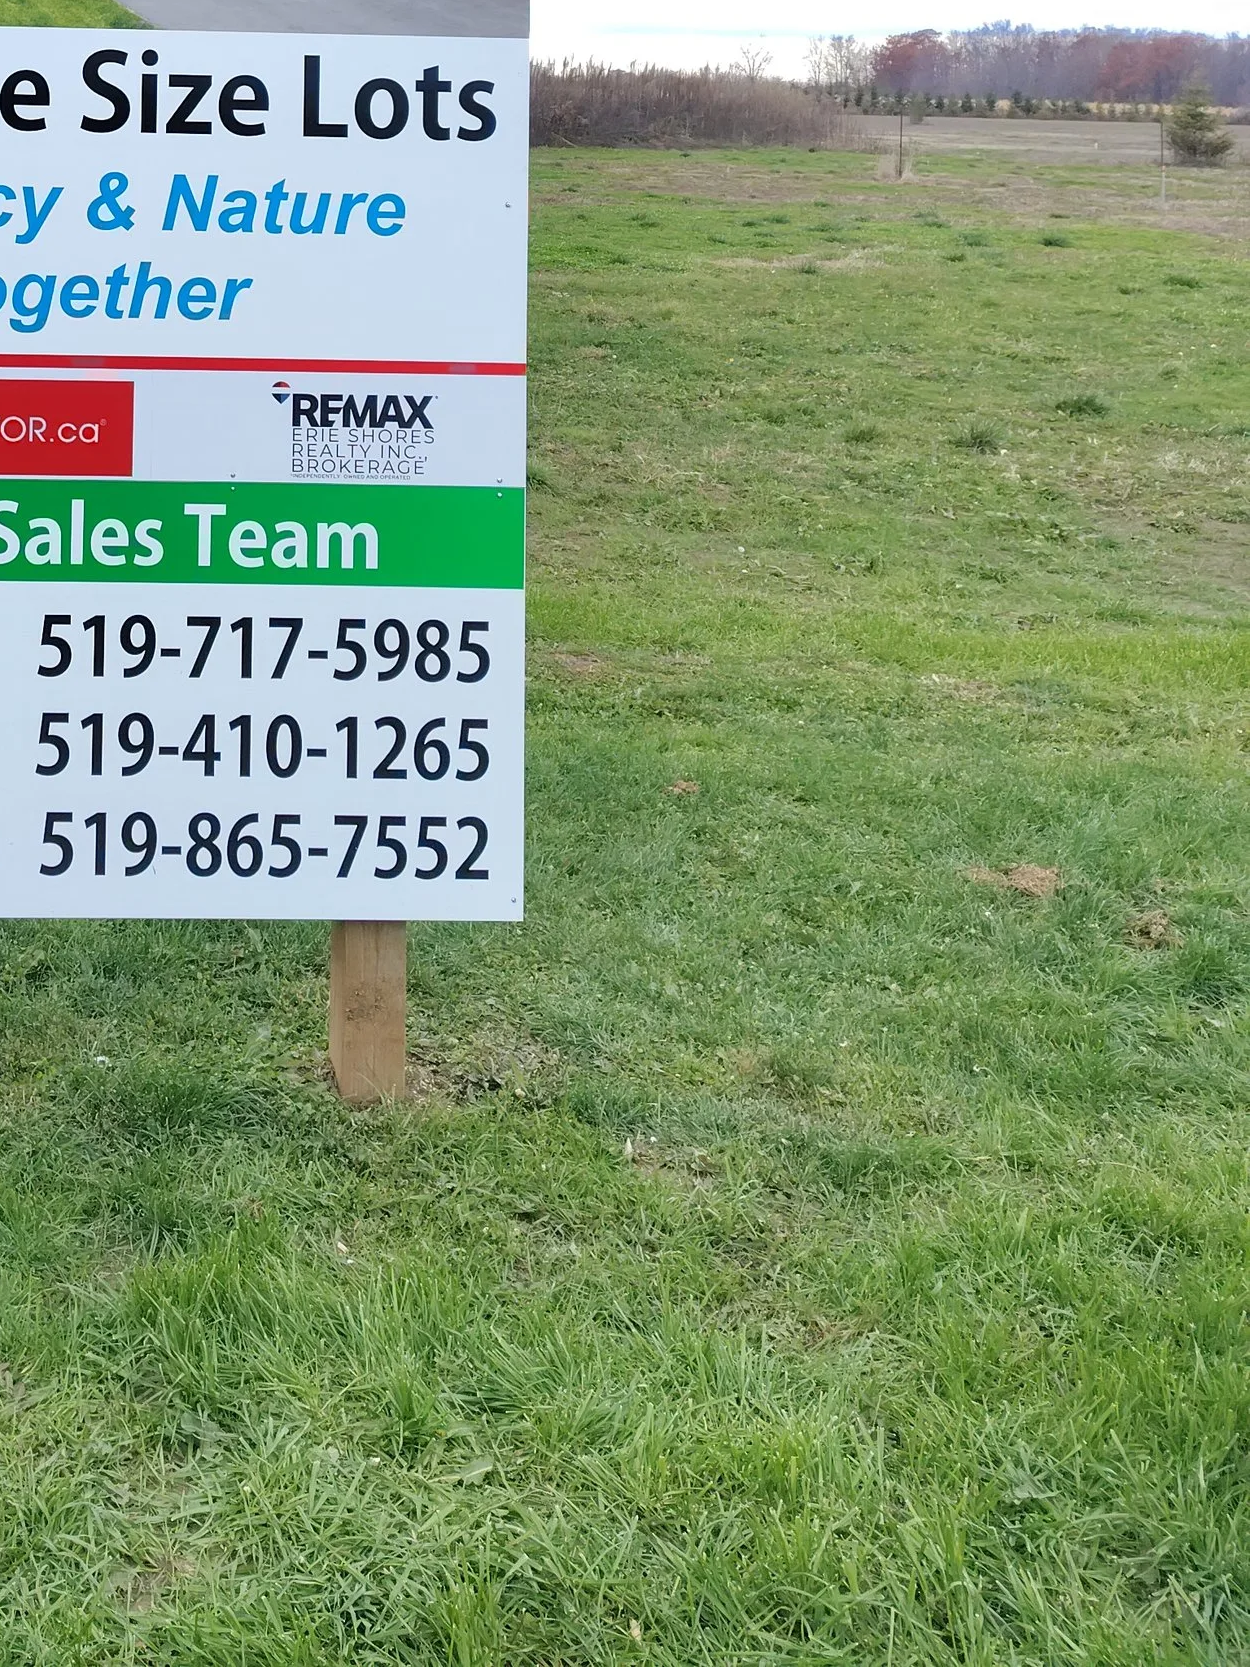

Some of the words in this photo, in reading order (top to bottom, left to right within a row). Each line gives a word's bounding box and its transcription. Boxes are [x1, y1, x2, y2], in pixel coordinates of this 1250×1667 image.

[79, 48, 270, 137] Size
[302, 54, 498, 143] Lots
[86, 171, 136, 232] &
[161, 173, 406, 237] Nature
[291, 458, 425, 475] BROKERAGE
[292, 428, 340, 443] ERIE
[348, 428, 435, 445] SHORES
[292, 443, 372, 459] REALTY
[183, 503, 380, 570] Team
[37, 614, 491, 684] 519-717-5985
[35, 712, 490, 782] 519-410-1265
[39, 811, 489, 880] 519-865-7552
